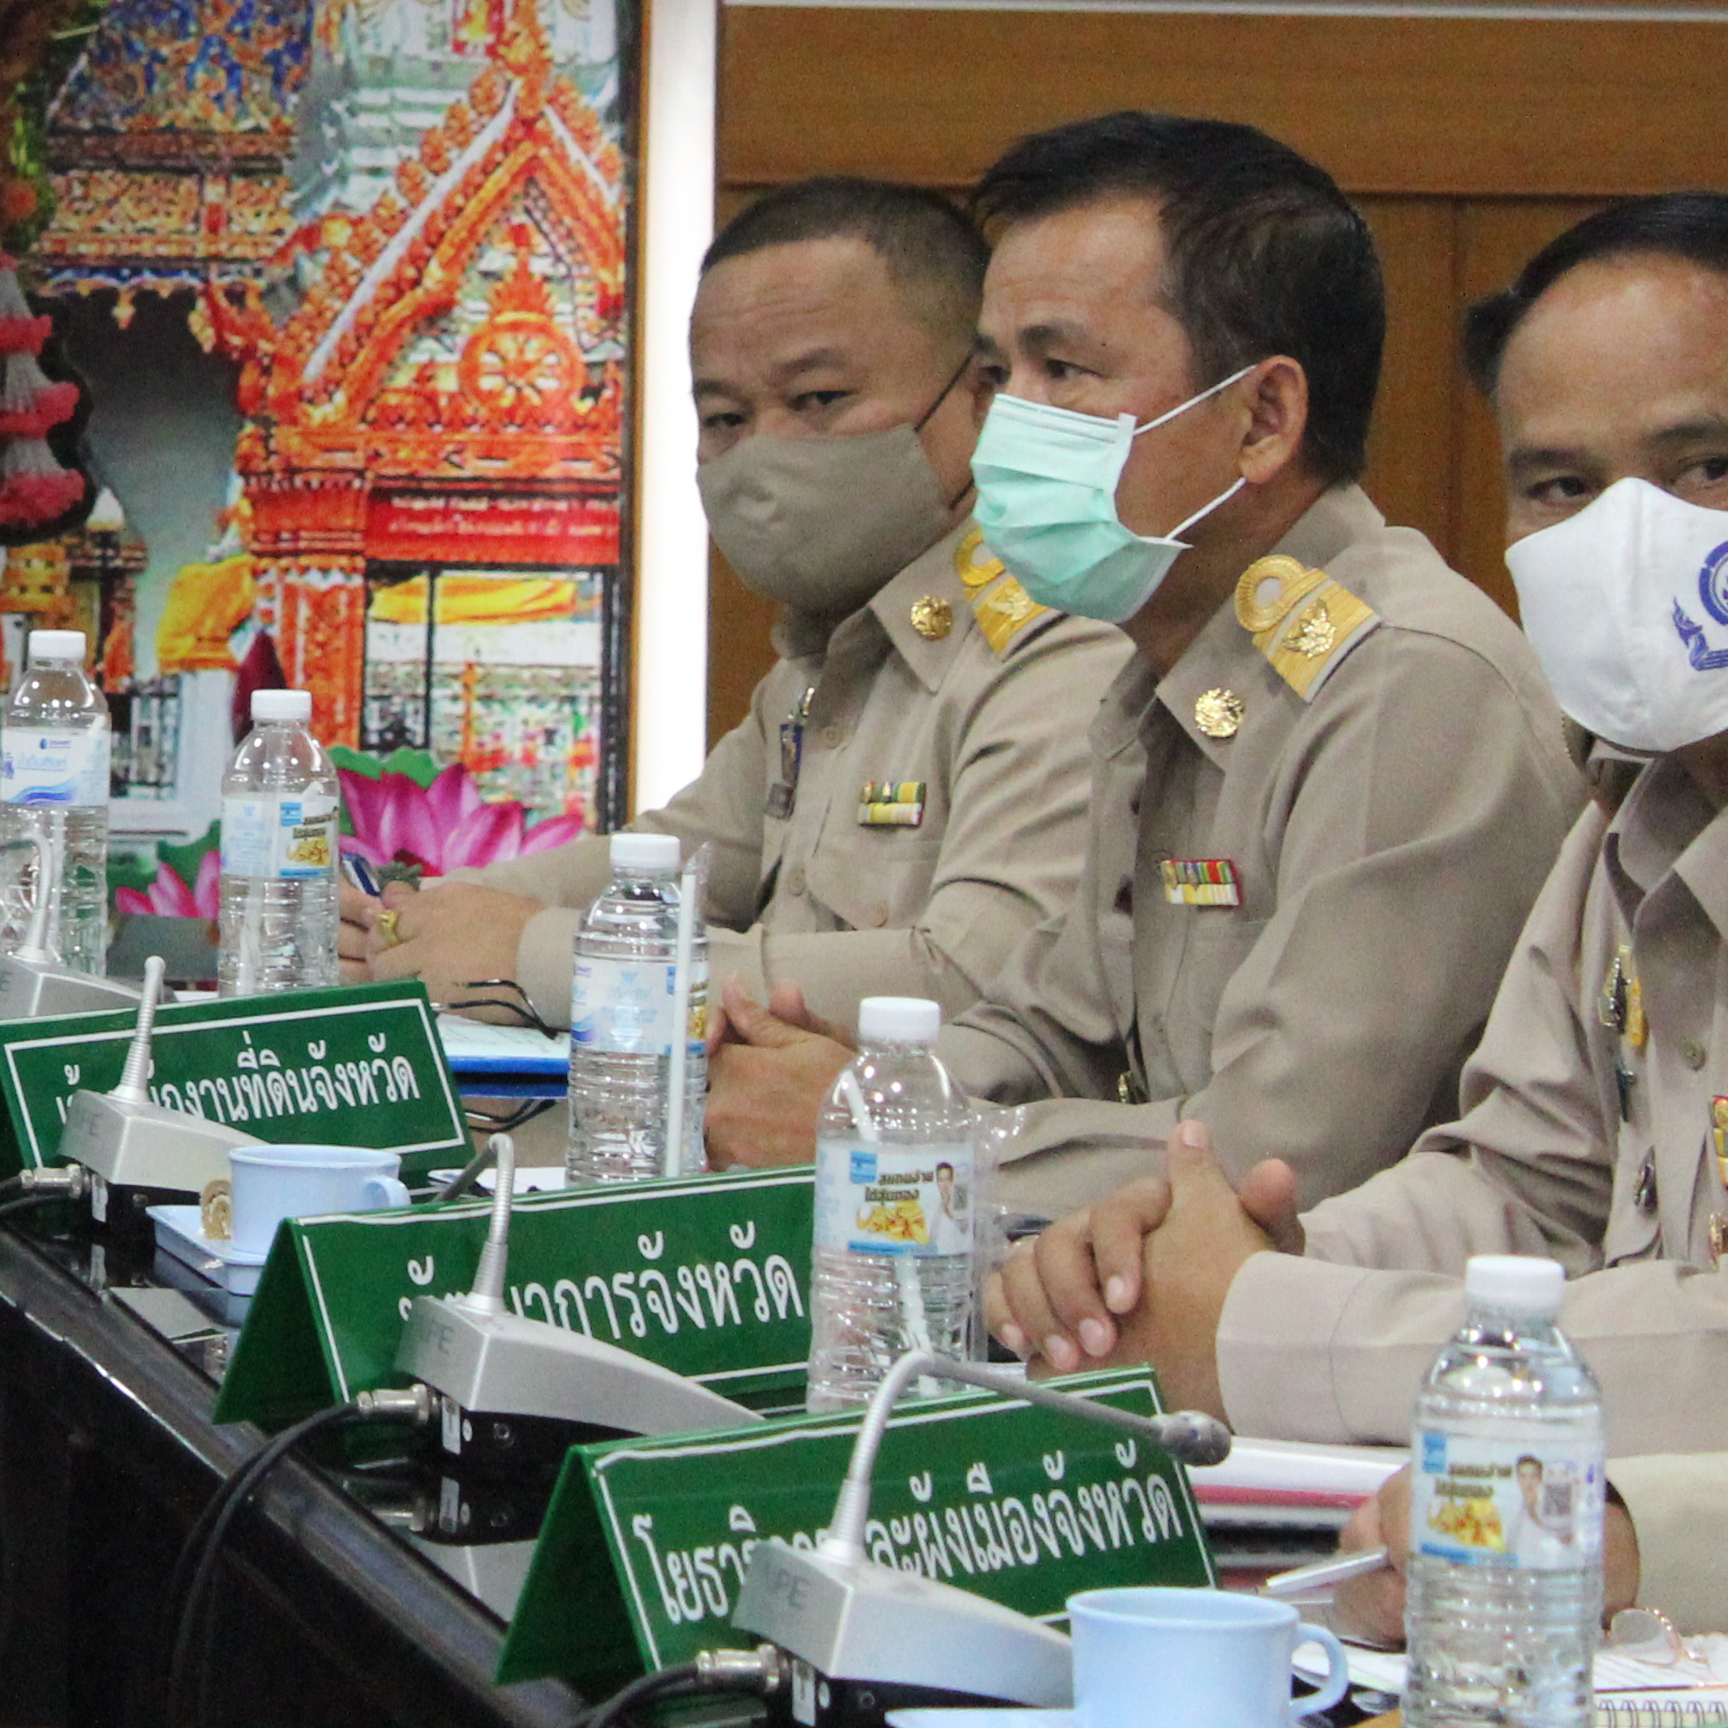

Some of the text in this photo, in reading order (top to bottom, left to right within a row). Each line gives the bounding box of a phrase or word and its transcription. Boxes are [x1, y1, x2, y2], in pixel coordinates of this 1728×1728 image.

[55, 1030, 421, 1126] เ้กงานที่ดินจังหวัด
[399, 1221, 805, 1341] ัาการจังหวัด
[632, 1439, 1184, 1624] โยธาิละผังเมืองจังหวัด
